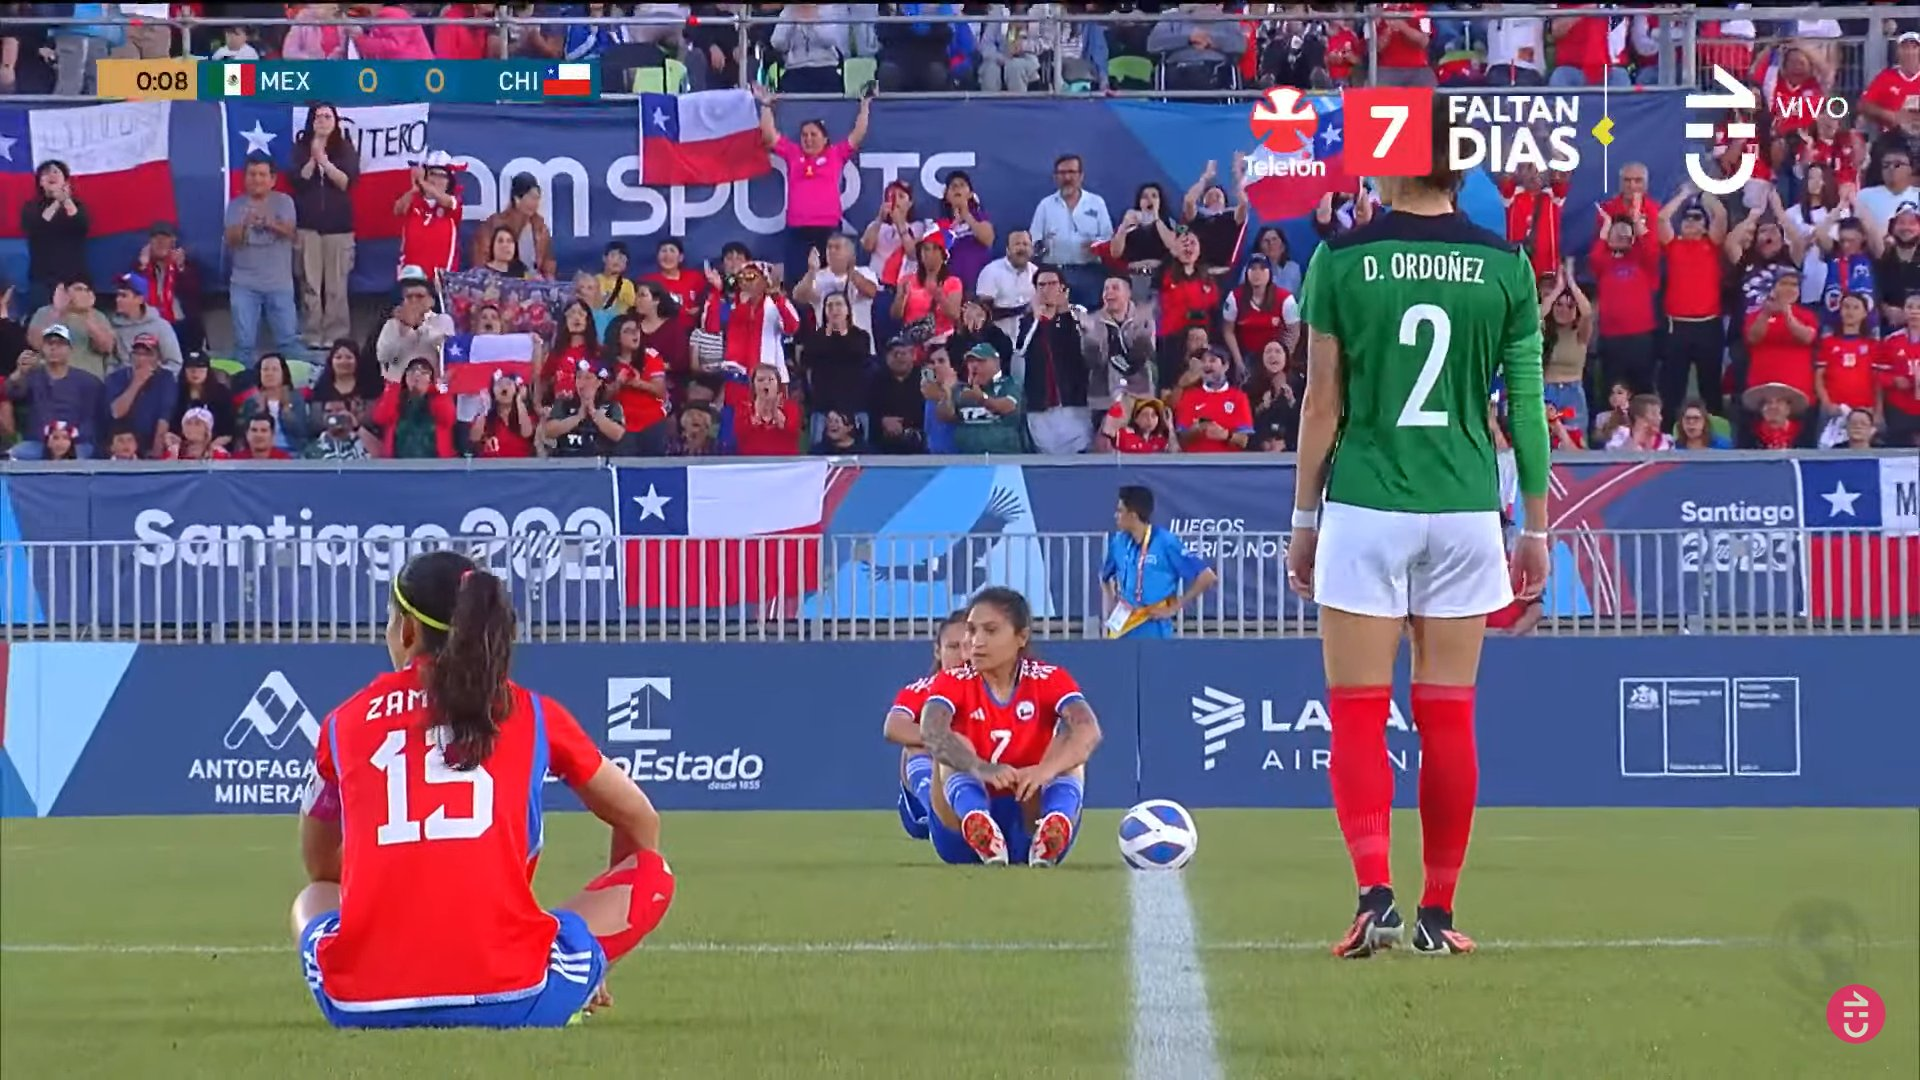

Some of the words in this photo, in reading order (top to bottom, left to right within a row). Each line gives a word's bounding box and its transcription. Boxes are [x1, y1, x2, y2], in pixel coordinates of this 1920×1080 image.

[1363, 255, 1385, 282] D.
[1391, 251, 1485, 284] ORDOÑEZ
[1396, 303, 1452, 427] 2
[1681, 500, 1795, 526] Santiago
[132, 507, 450, 581] Santiago
[1681, 531, 1794, 573] 2023
[365, 688, 429, 721] ZAM
[990, 729, 1013, 763] 7
[187, 758, 318, 779] ANTOFAGA
[214, 783, 304, 804] MINERA
[369, 724, 494, 847] 15
